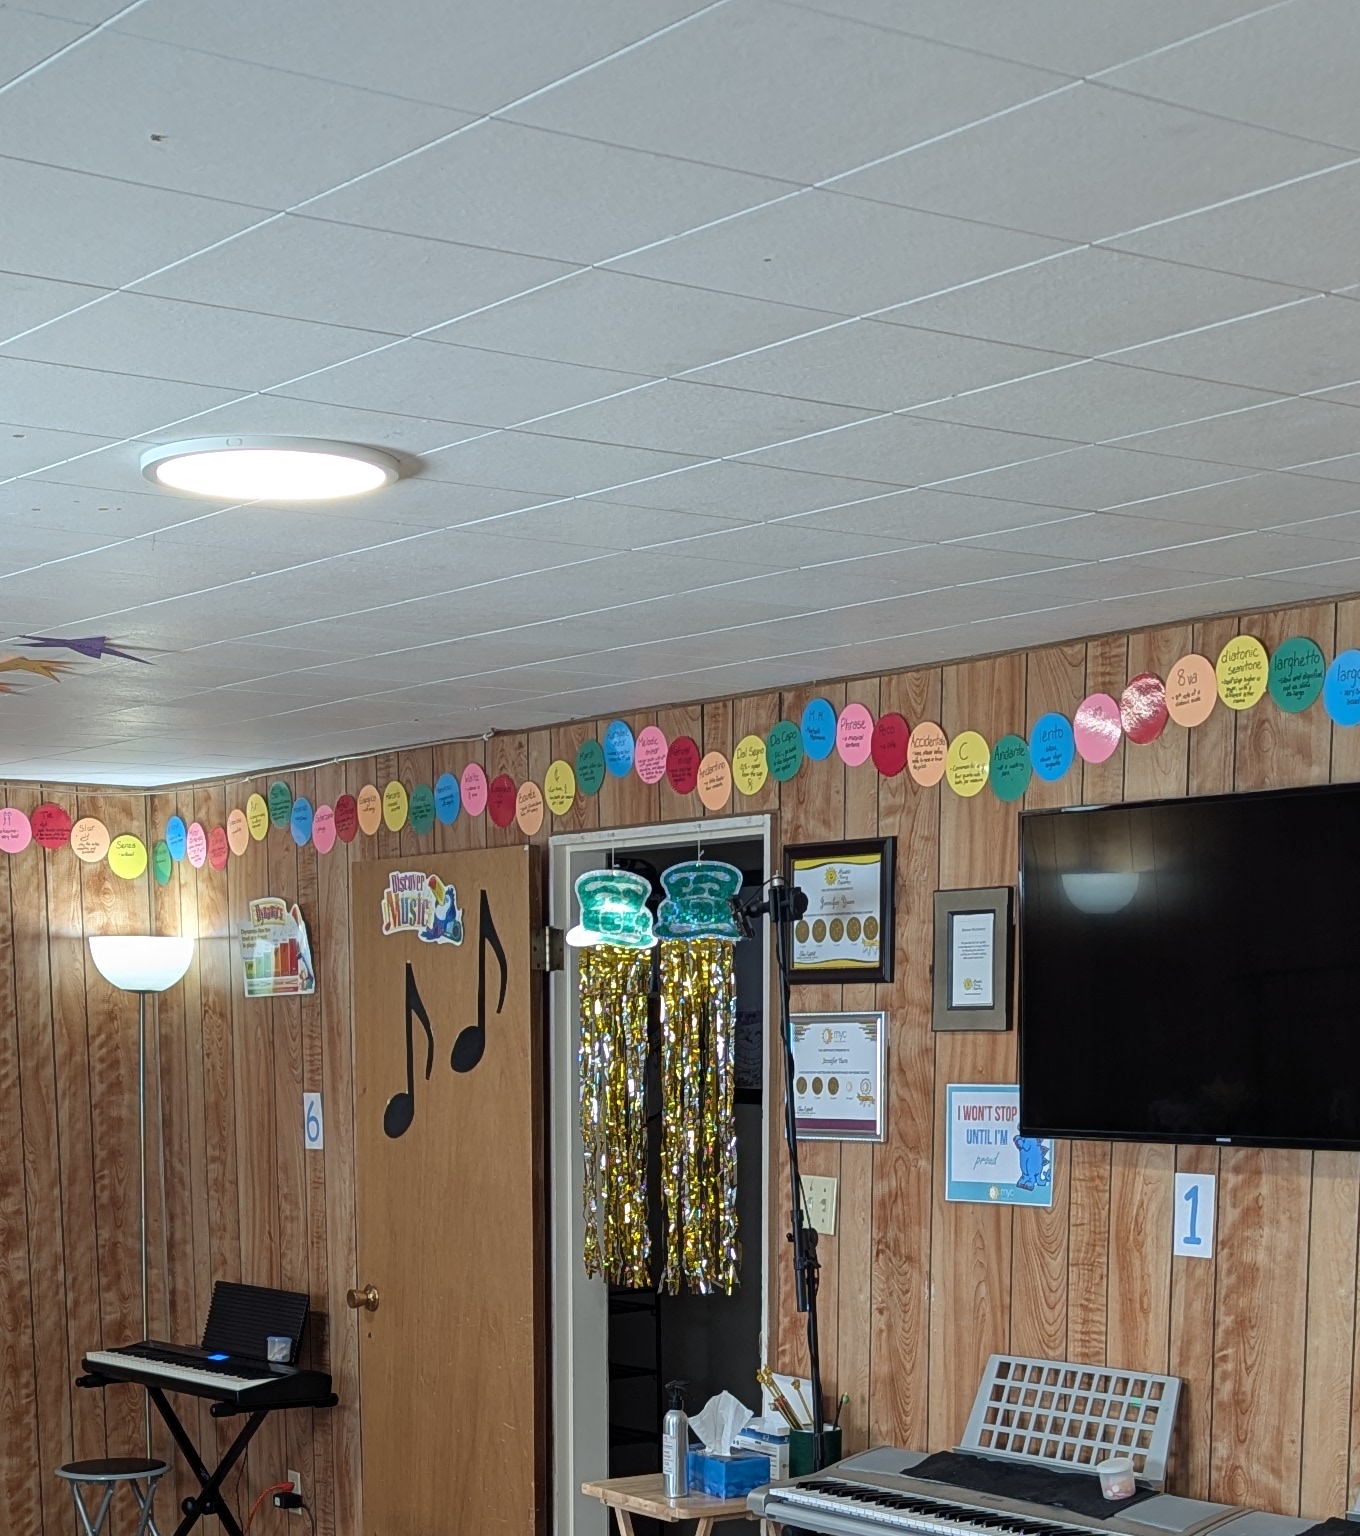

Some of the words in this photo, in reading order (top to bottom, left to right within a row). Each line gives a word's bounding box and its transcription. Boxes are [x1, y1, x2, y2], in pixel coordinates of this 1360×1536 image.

[1220, 646, 1259, 664] diatonic
[1274, 649, 1321, 677] larghetto
[840, 717, 867, 732] Phrase
[1039, 724, 1064, 744] lento
[994, 743, 1026, 761] Andante
[391, 873, 425, 894] Discover
[386, 890, 429, 928] Music
[306, 1100, 320, 1143] 6
[957, 1105, 960, 1121] I
[963, 1105, 993, 1121] WON'T
[994, 1105, 1018, 1122] STOP
[966, 1128, 992, 1145] UNTIL
[994, 1129, 1008, 1145] I'M
[973, 1151, 999, 1170] proud
[1184, 1185, 1201, 1245] 1
